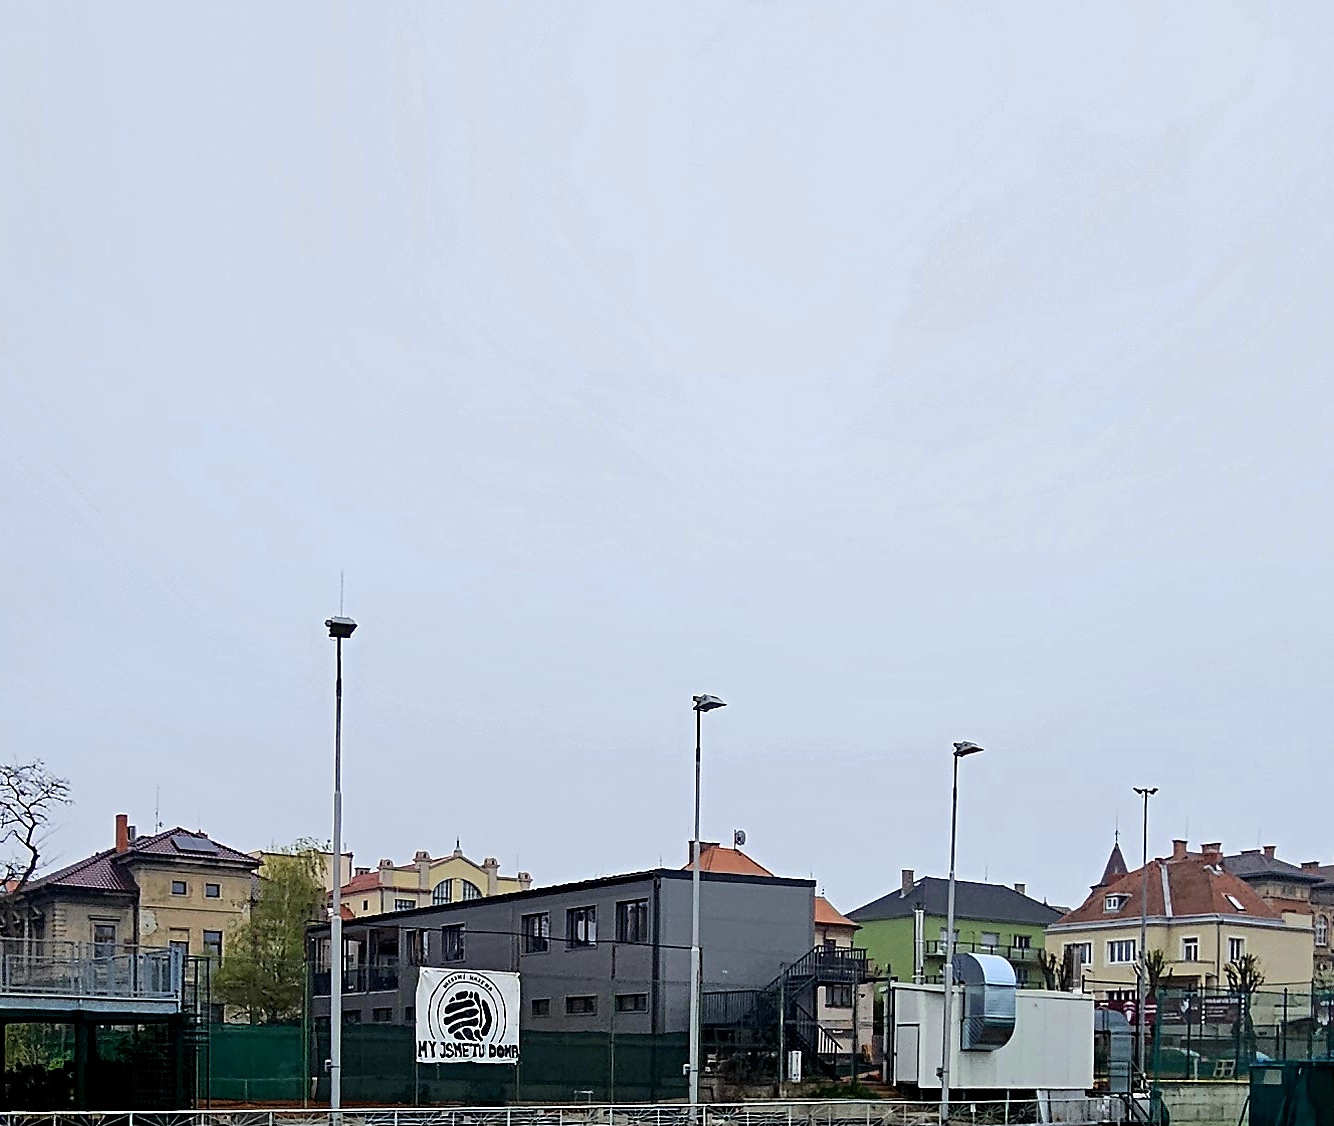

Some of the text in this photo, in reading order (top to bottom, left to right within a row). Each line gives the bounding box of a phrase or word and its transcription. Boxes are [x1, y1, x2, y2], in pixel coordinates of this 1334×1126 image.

[417, 1040, 520, 1058] MY JSME TU DOMA
